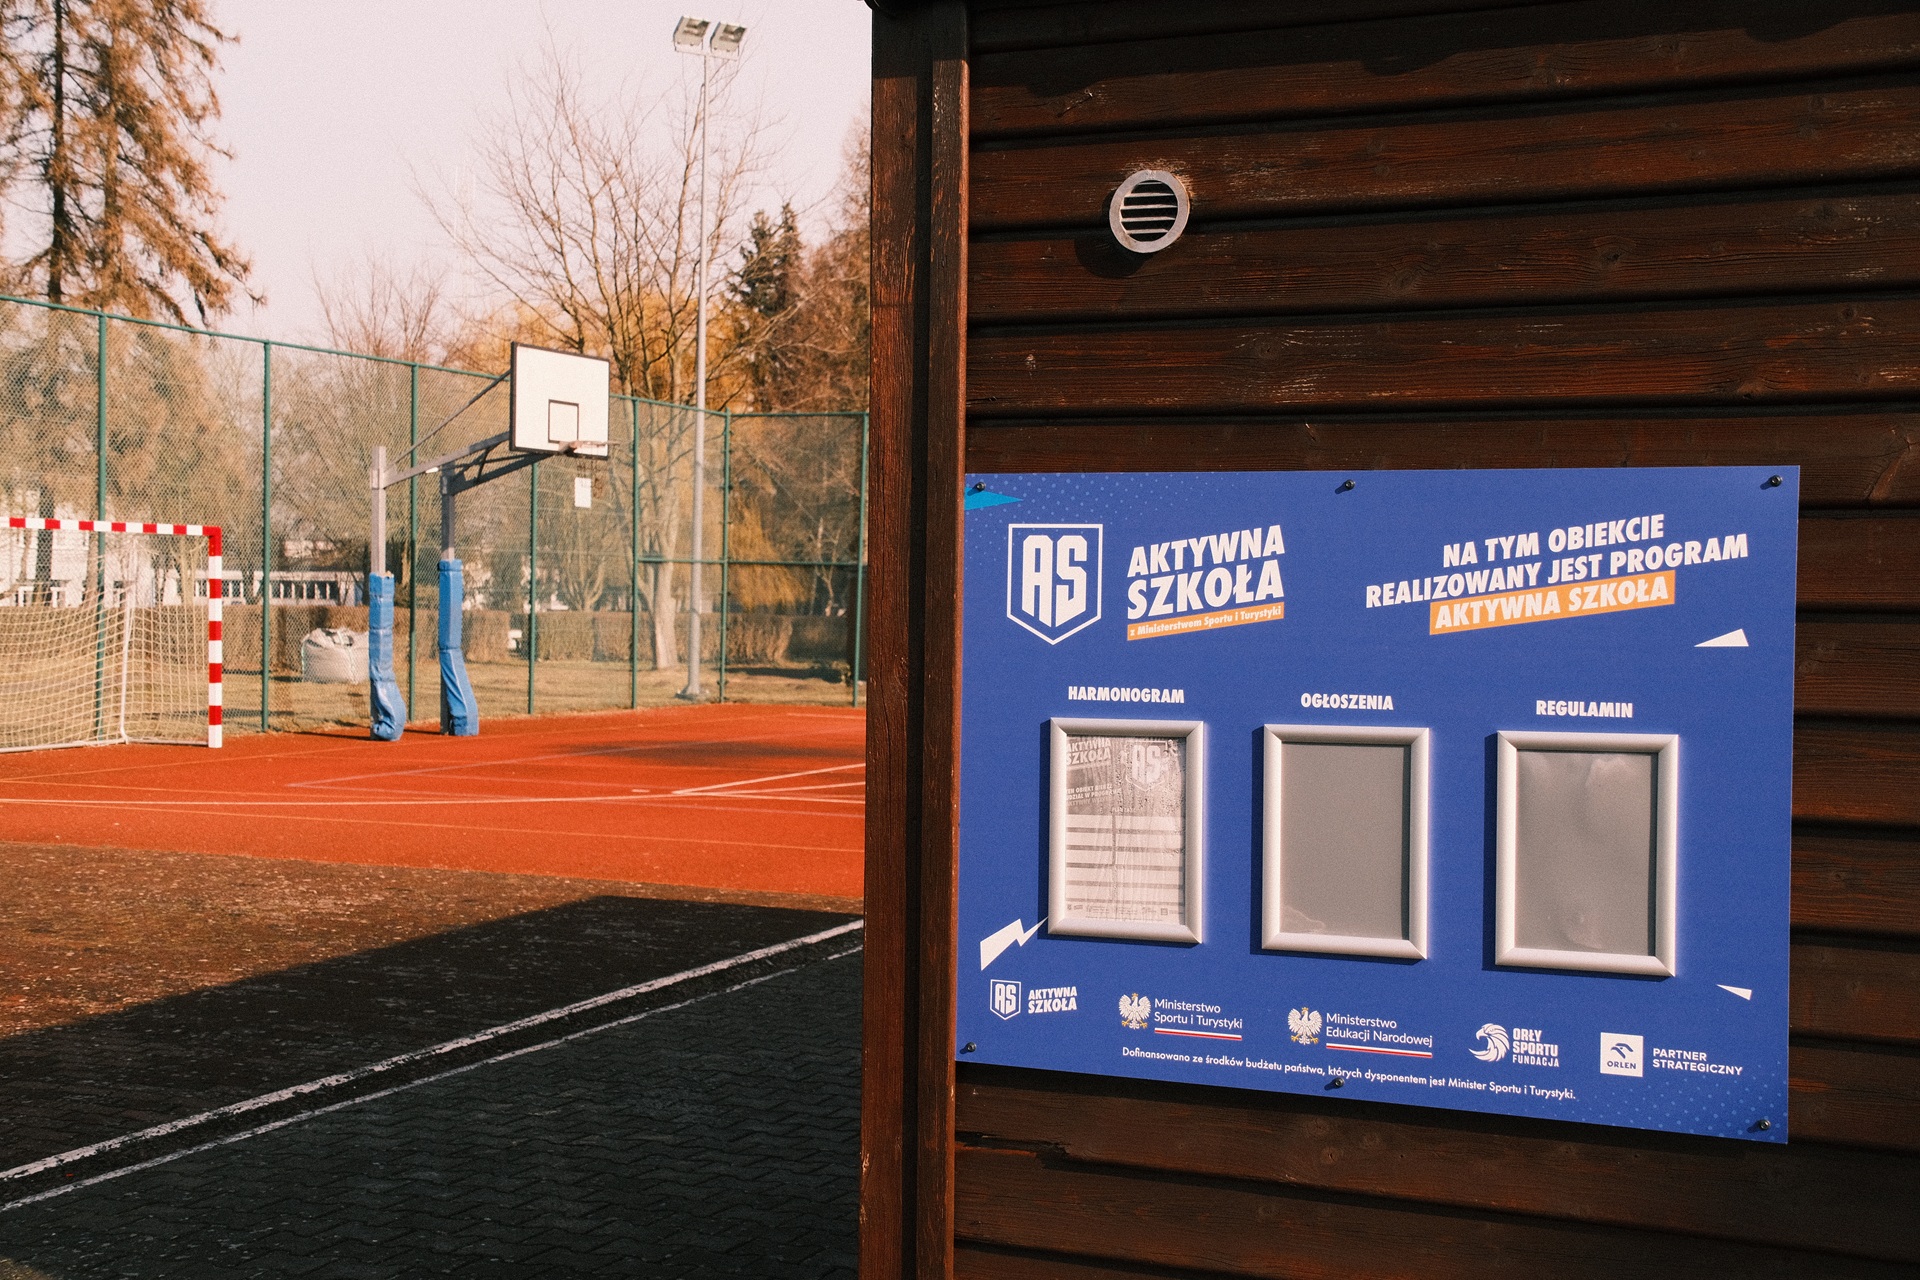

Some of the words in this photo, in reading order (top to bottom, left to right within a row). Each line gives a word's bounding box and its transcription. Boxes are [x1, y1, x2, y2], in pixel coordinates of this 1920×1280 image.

[1443, 541, 1478, 567] NA
[1485, 532, 1539, 562] TYM
[1548, 514, 1664, 552] OBIEKCIE
[1127, 525, 1285, 577] AKTYWNA
[1366, 562, 1541, 608] REALIZOWANY
[1547, 554, 1602, 584] JEST
[1610, 533, 1748, 574] PROGRAM
[1022, 535, 1088, 627] AS
[1127, 559, 1285, 620] SZKOŁA
[1434, 590, 1560, 629] AKTYWNA
[1569, 576, 1668, 612] SZKOŁA
[1137, 619, 1202, 635] Ministerstwem
[1204, 612, 1232, 627] Sportu
[1240, 606, 1281, 621] Turystyki
[1068, 686, 1184, 703] HARMONOGRAM
[1301, 692, 1394, 711] OGŁOSZENIA
[1536, 700, 1633, 718] REGULAMIN
[1131, 745, 1161, 784] AS
[994, 983, 1016, 1015] AS
[1028, 986, 1077, 1000] AKTYWNA
[1028, 997, 1077, 1014] SZKOŁA
[1154, 998, 1221, 1014] Ministerstwo
[1154, 1011, 1188, 1027] Sportu
[1190, 1013, 1194, 1024] i
[1196, 1015, 1243, 1029] Turystyki
[1326, 1013, 1397, 1029] Ministerstwo
[1326, 1027, 1370, 1041] Edukacji
[1373, 1030, 1433, 1048] Narodowej
[1513, 1028, 1542, 1043] ORŁY
[1512, 1041, 1559, 1057] SPORTU
[1653, 1047, 1707, 1062] PARTNER
[1512, 1054, 1560, 1068] FUNDACJA
[1606, 1060, 1637, 1070] ORLEN
[1652, 1059, 1743, 1076] STRATEGICZNY
[1122, 1046, 1190, 1063] Dofinansowano
[1192, 1055, 1203, 1063] ze
[1205, 1052, 1243, 1067] środków
[1245, 1057, 1282, 1071] budżetu
[1284, 1061, 1326, 1077] państwa,
[1328, 1066, 1362, 1081] których
[1364, 1070, 1427, 1086] dysponentem
[1429, 1075, 1446, 1088] jest
[1448, 1077, 1487, 1091] Minister
[1489, 1081, 1521, 1097] Sportu
[1530, 1085, 1576, 1101] Turystyki.
